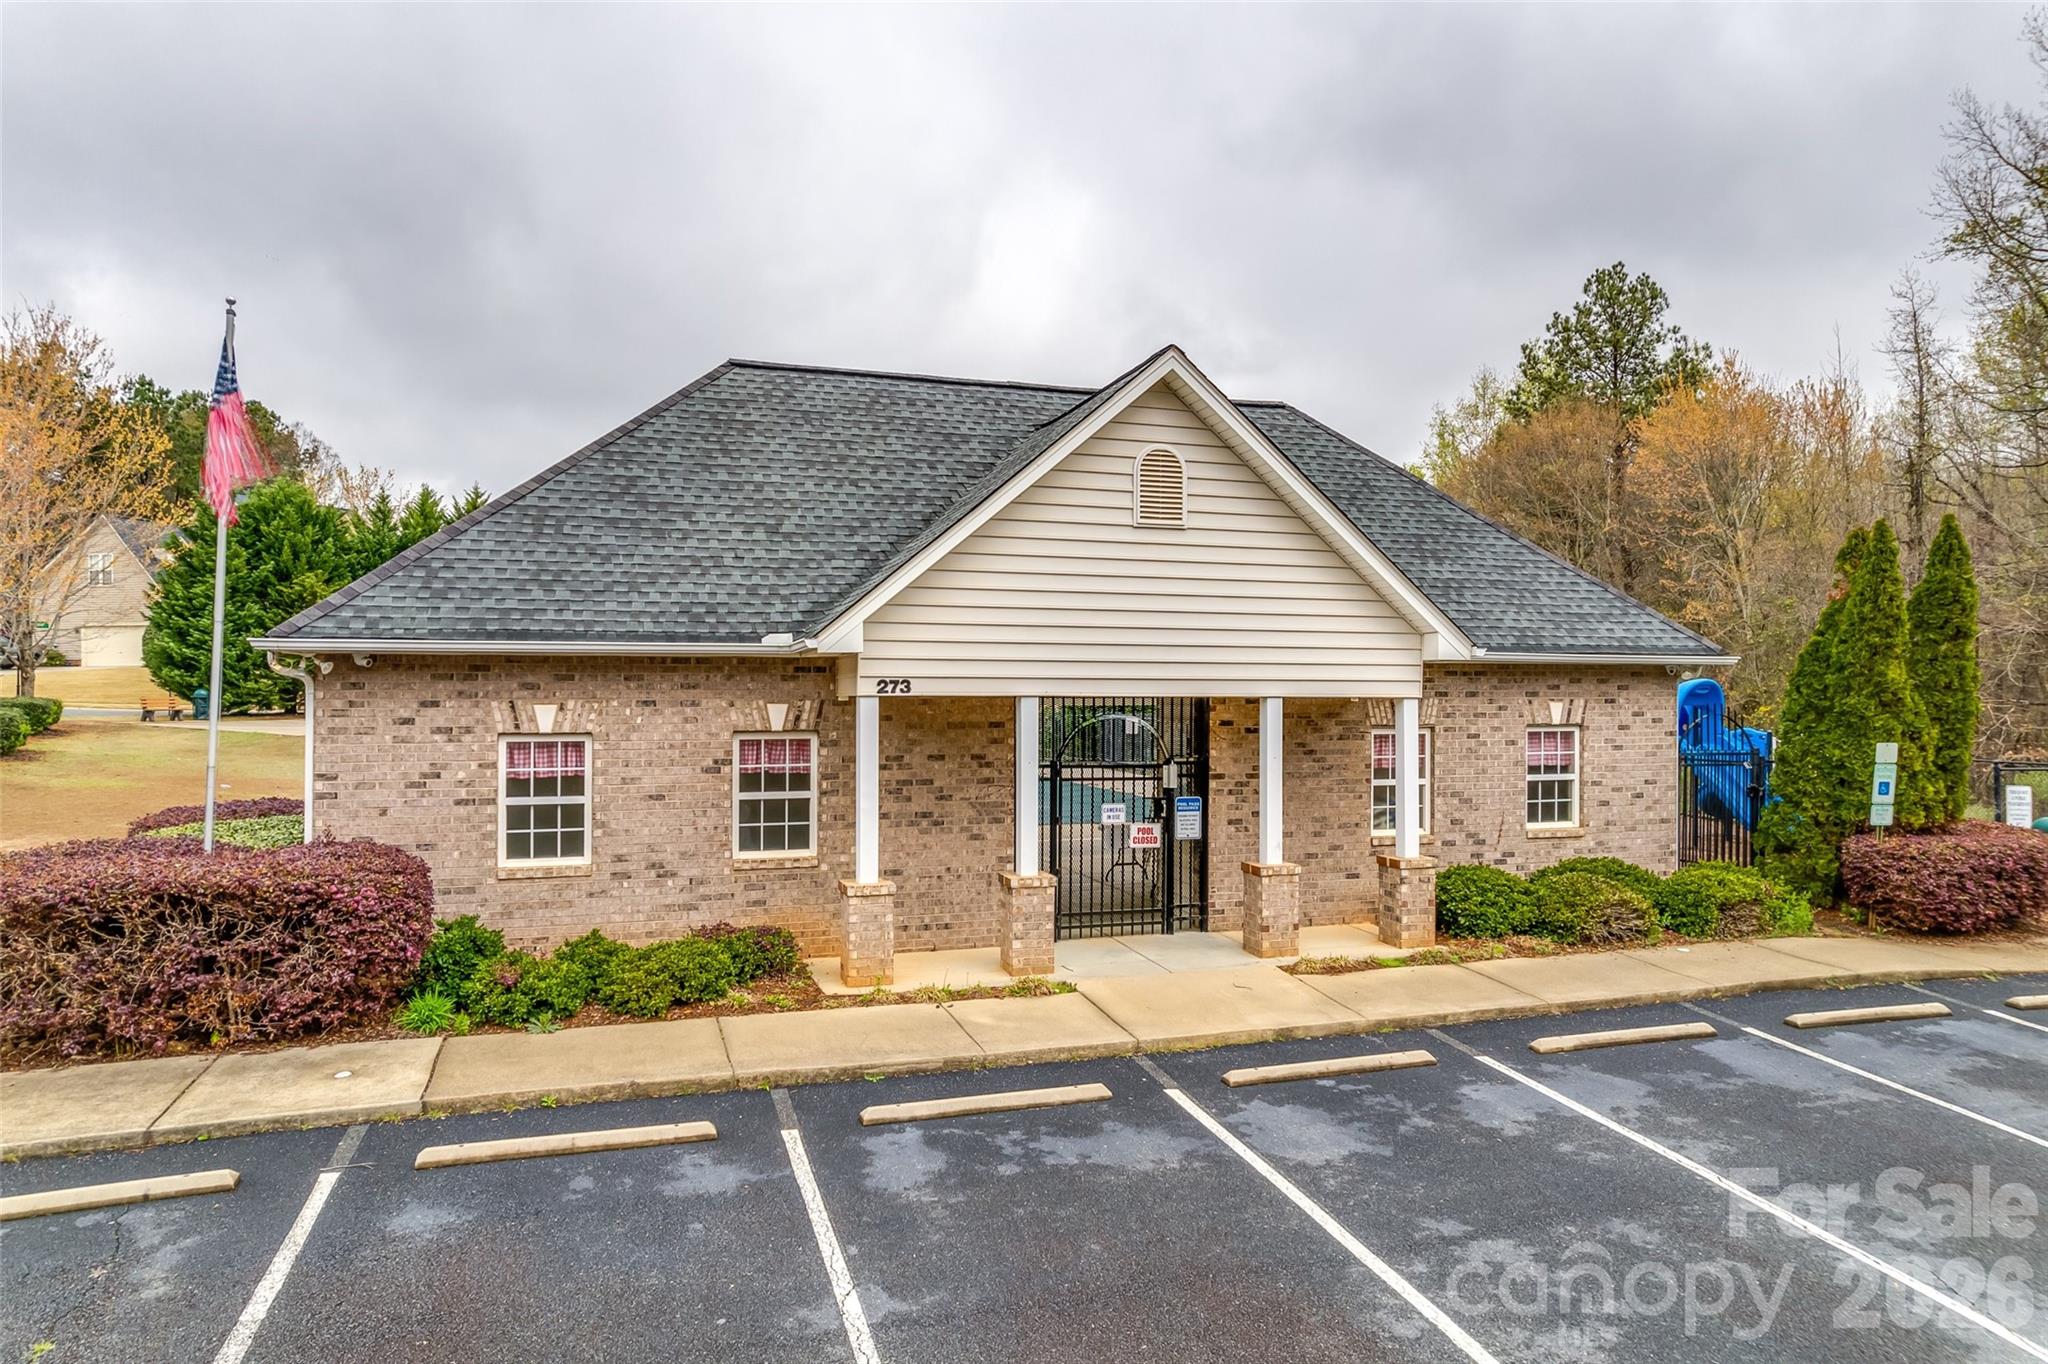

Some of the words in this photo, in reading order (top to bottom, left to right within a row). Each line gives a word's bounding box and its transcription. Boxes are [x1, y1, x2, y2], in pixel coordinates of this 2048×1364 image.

[877, 679, 912, 694] 273
[1137, 827, 1154, 835] POOL
[1133, 836, 1158, 845] CLOSED
